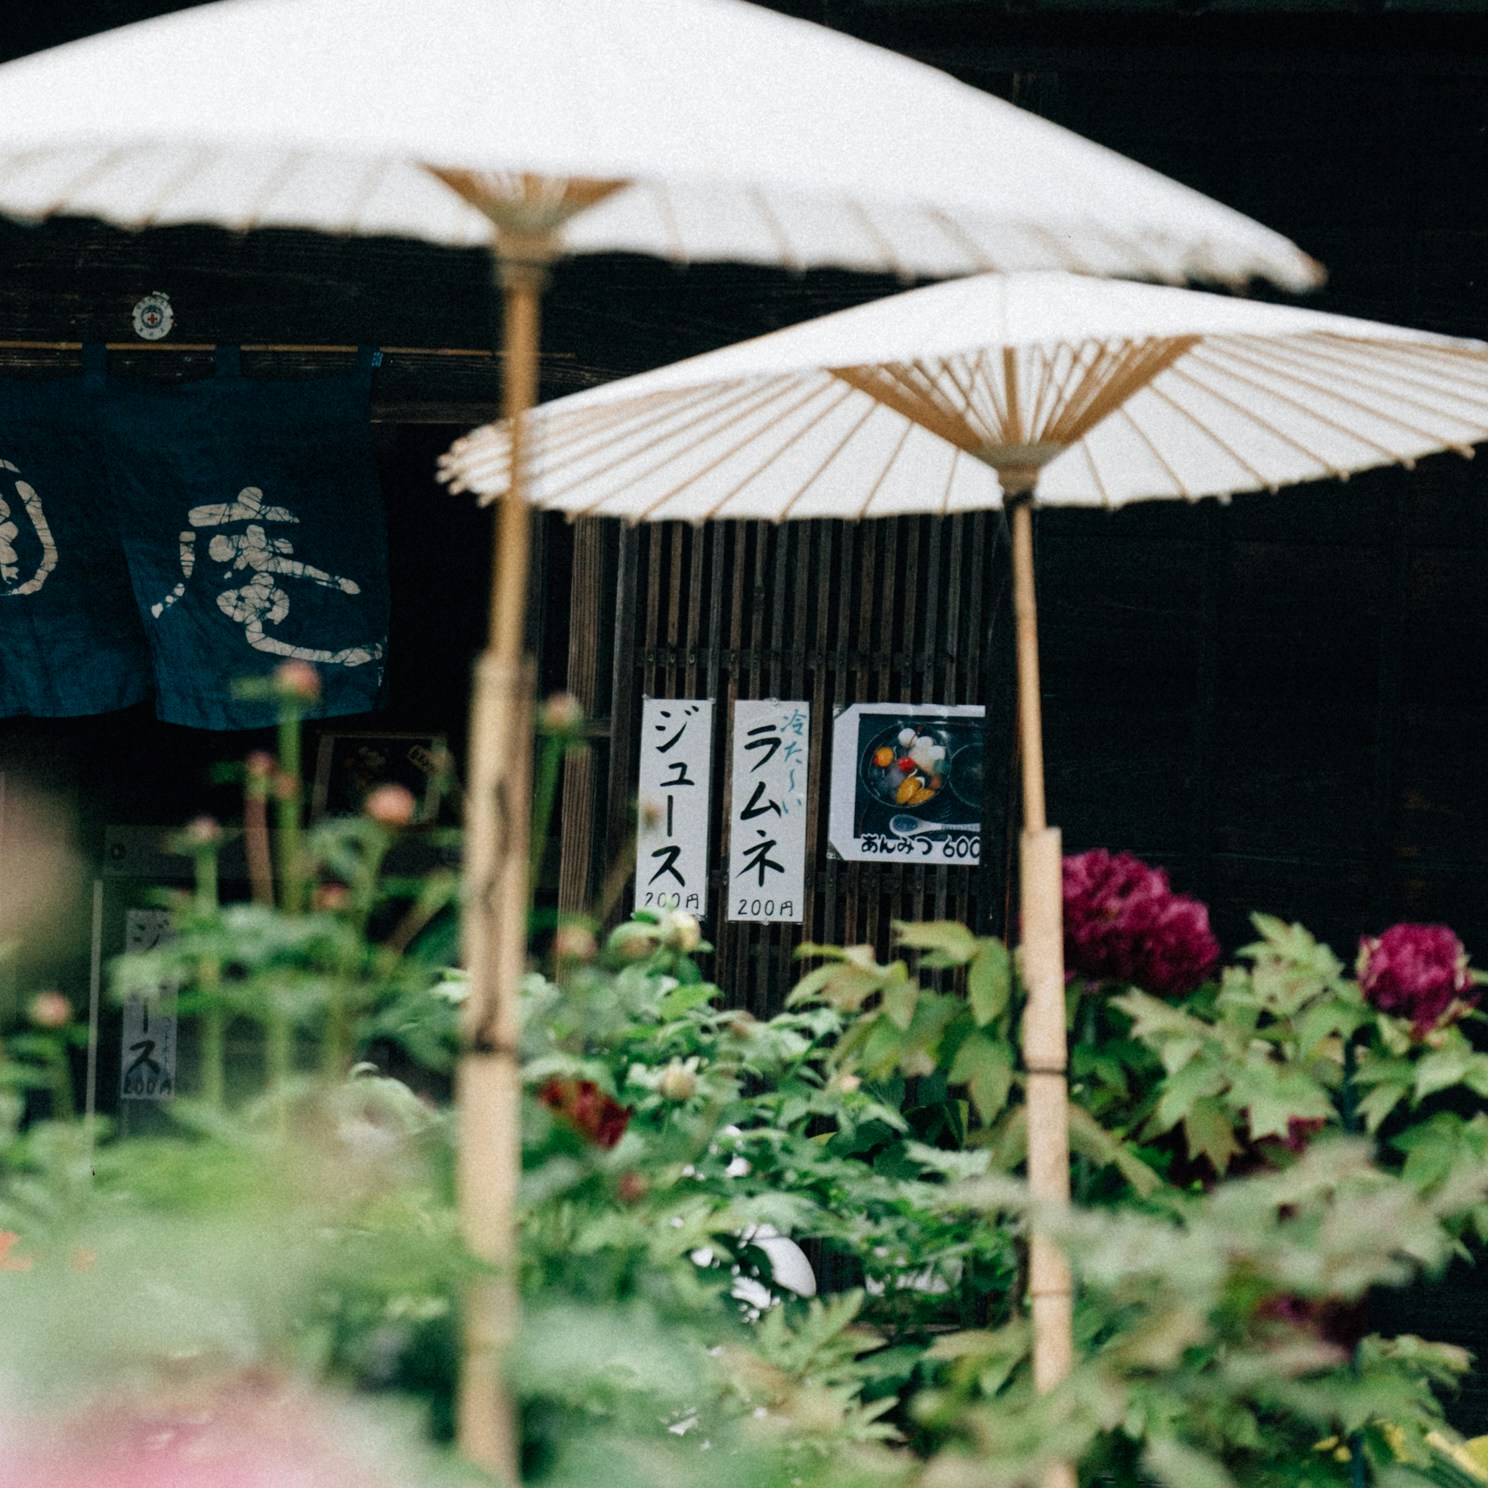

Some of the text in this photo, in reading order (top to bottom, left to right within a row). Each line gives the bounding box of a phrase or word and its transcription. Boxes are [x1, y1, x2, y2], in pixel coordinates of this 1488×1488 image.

[647, 705, 699, 888] ジュース
[735, 724, 785, 888] ラムネ
[860, 833, 933, 855] あんみつ
[738, 898, 794, 917] 200円
